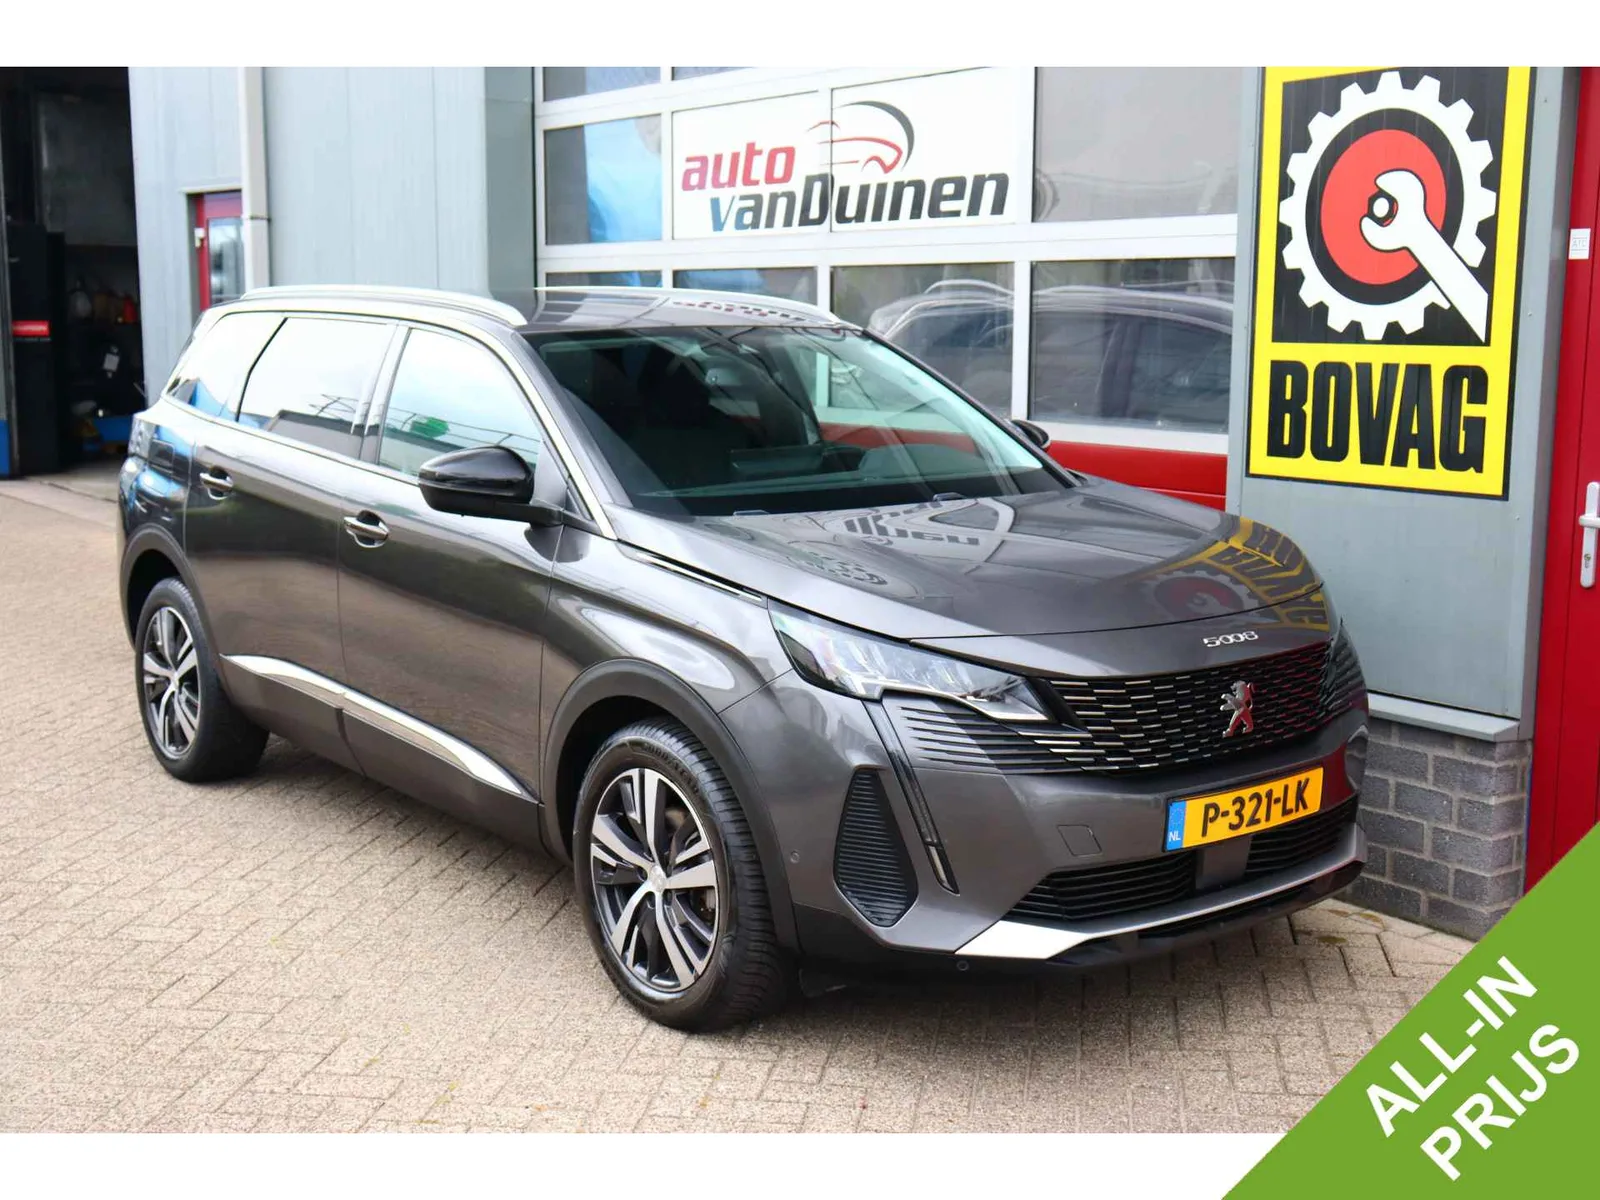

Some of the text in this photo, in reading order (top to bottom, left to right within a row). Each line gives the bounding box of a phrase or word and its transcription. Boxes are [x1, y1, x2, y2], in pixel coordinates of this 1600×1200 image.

[681, 142, 796, 191] auto
[1266, 359, 1489, 474] BOVAG
[1203, 630, 1259, 648] 5008
[1201, 777, 1310, 838] P-321-LK
[1168, 831, 1182, 842] NL
